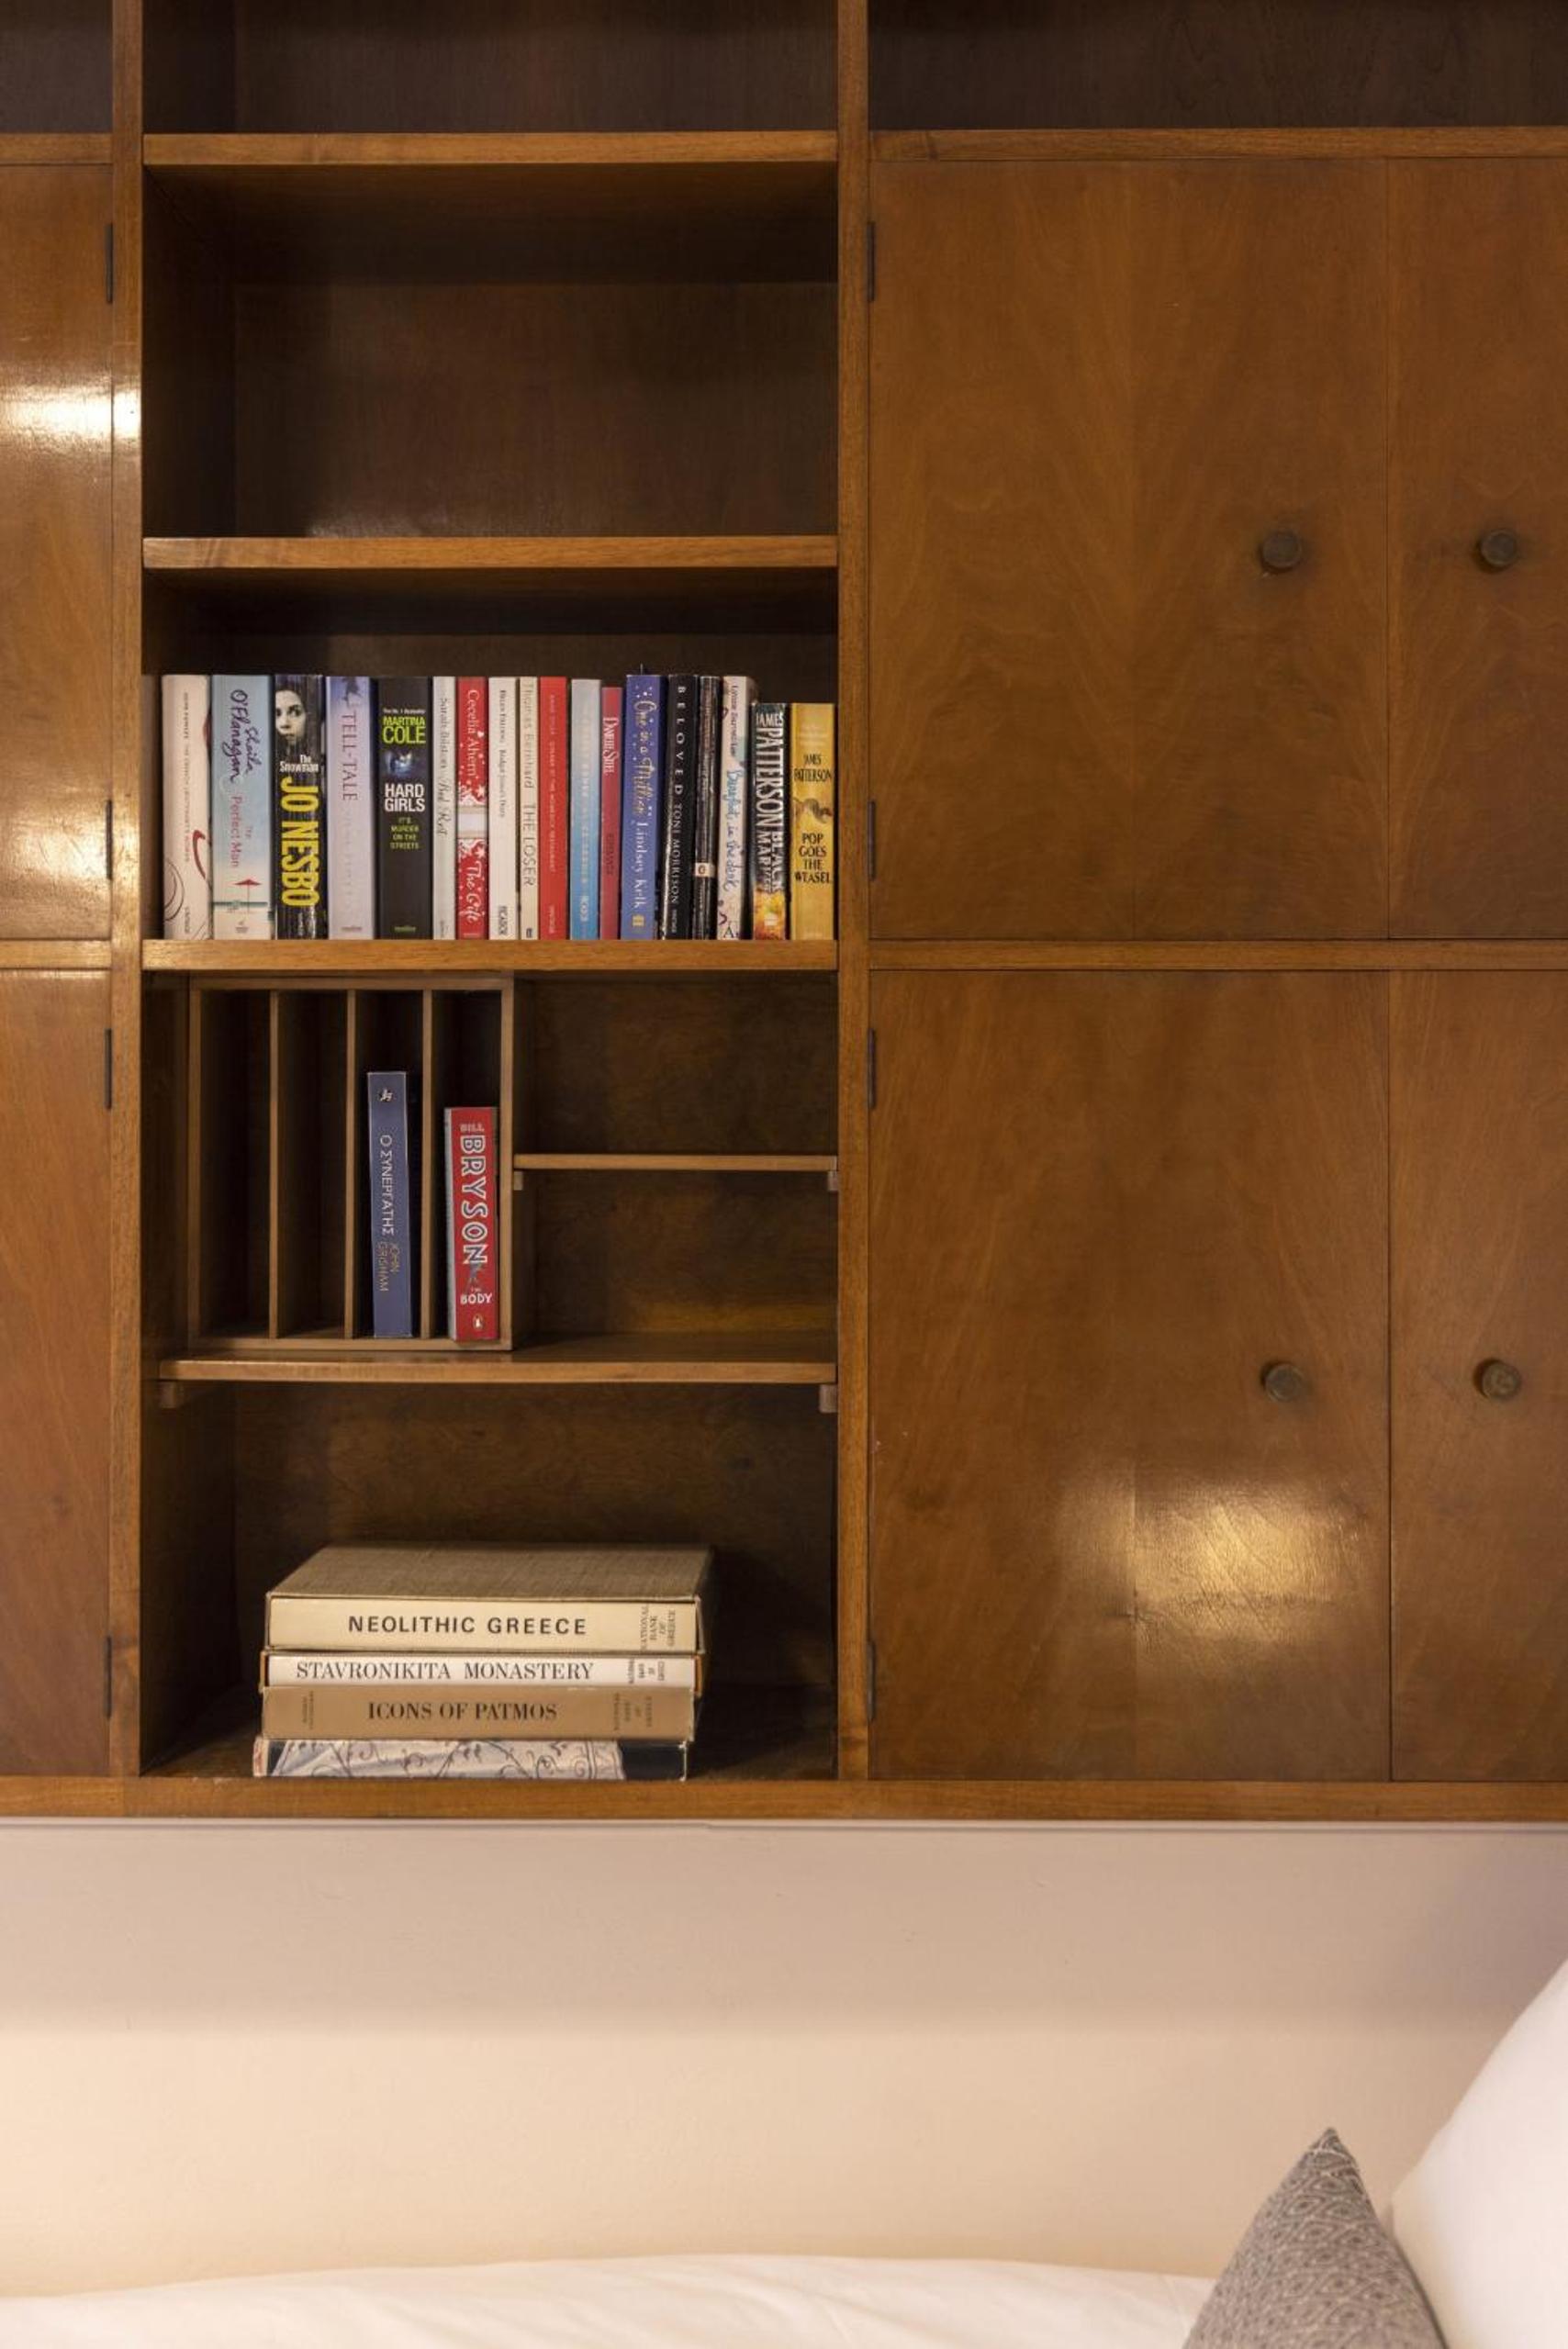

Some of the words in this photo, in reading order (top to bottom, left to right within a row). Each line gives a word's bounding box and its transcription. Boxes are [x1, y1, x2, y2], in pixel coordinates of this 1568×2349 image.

[384, 716, 426, 726] MARTINA
[467, 689, 480, 735] Cecelia
[756, 710, 783, 727] JAMES
[383, 726, 427, 744] COLE
[674, 686, 687, 796] BELOVED
[280, 761, 319, 773] Snowman
[300, 755, 312, 764] The
[342, 710, 358, 802] TELL-TALE
[467, 737, 479, 777] Ahern
[385, 783, 425, 798] HARD
[756, 726, 783, 828] PATTERSON
[281, 776, 319, 813] JO
[385, 798, 426, 812] GIRLS
[230, 795, 242, 840] Perfect
[522, 802, 537, 832] THE
[672, 802, 683, 833] TONI
[632, 822, 649, 873] Lindsey
[798, 845, 827, 858] GOES
[801, 832, 823, 845] POP
[230, 842, 241, 868] Man
[281, 821, 320, 907] NESBO
[521, 836, 537, 887] LOSER
[803, 858, 823, 870] THE
[466, 861, 483, 890] The
[670, 838, 682, 904] MORRISON
[794, 870, 831, 885] WEASEL
[459, 892, 483, 924] Gift
[633, 879, 648, 910] Kelk
[460, 1123, 485, 1133] BILL
[380, 1149, 394, 1237] ΣΥΝΕΡΓΑΤΗΣ
[460, 1135, 488, 1265] BRYSON
[460, 1292, 493, 1305] BODY
[348, 1615, 476, 1633] NEOLITHIC
[487, 1616, 588, 1636] GREECE
[649, 1616, 658, 1641] BANK
[297, 1661, 451, 1681] STAVRONIKITA
[464, 1662, 595, 1681] MONASTERY
[368, 1702, 432, 1720] ICONS
[439, 1702, 470, 1720] OF
[476, 1703, 559, 1722] PATMOS
